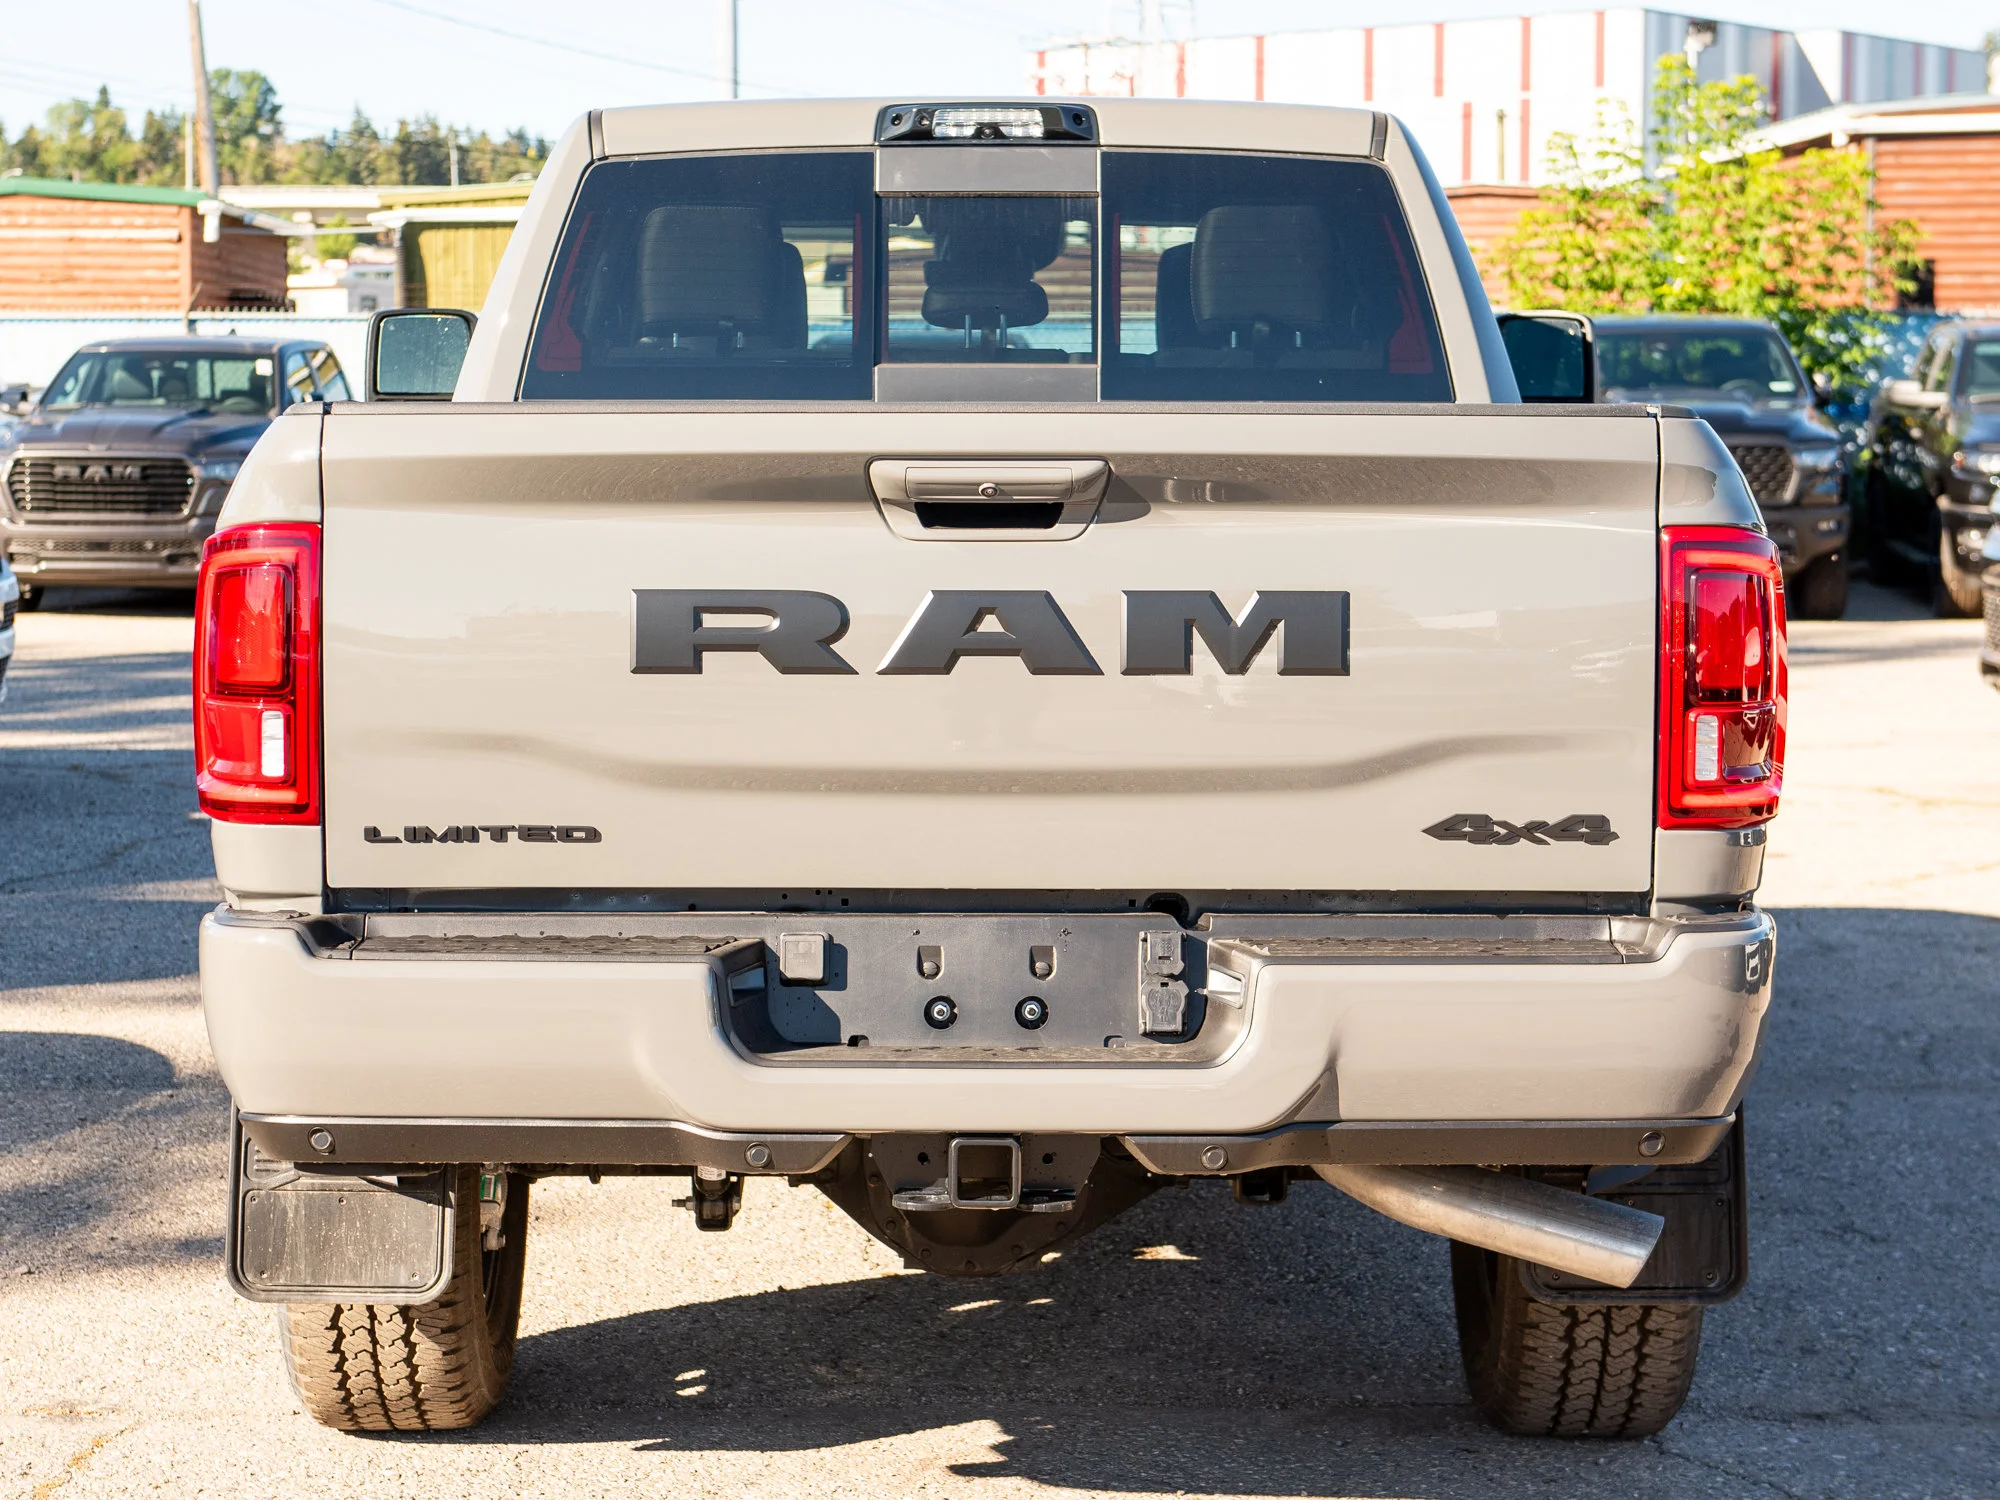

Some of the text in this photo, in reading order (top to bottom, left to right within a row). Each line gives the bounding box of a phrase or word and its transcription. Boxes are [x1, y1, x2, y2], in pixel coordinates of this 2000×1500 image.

[53, 464, 142, 481] RAM
[630, 589, 1350, 676] RAM
[364, 825, 602, 843] LIMITED
